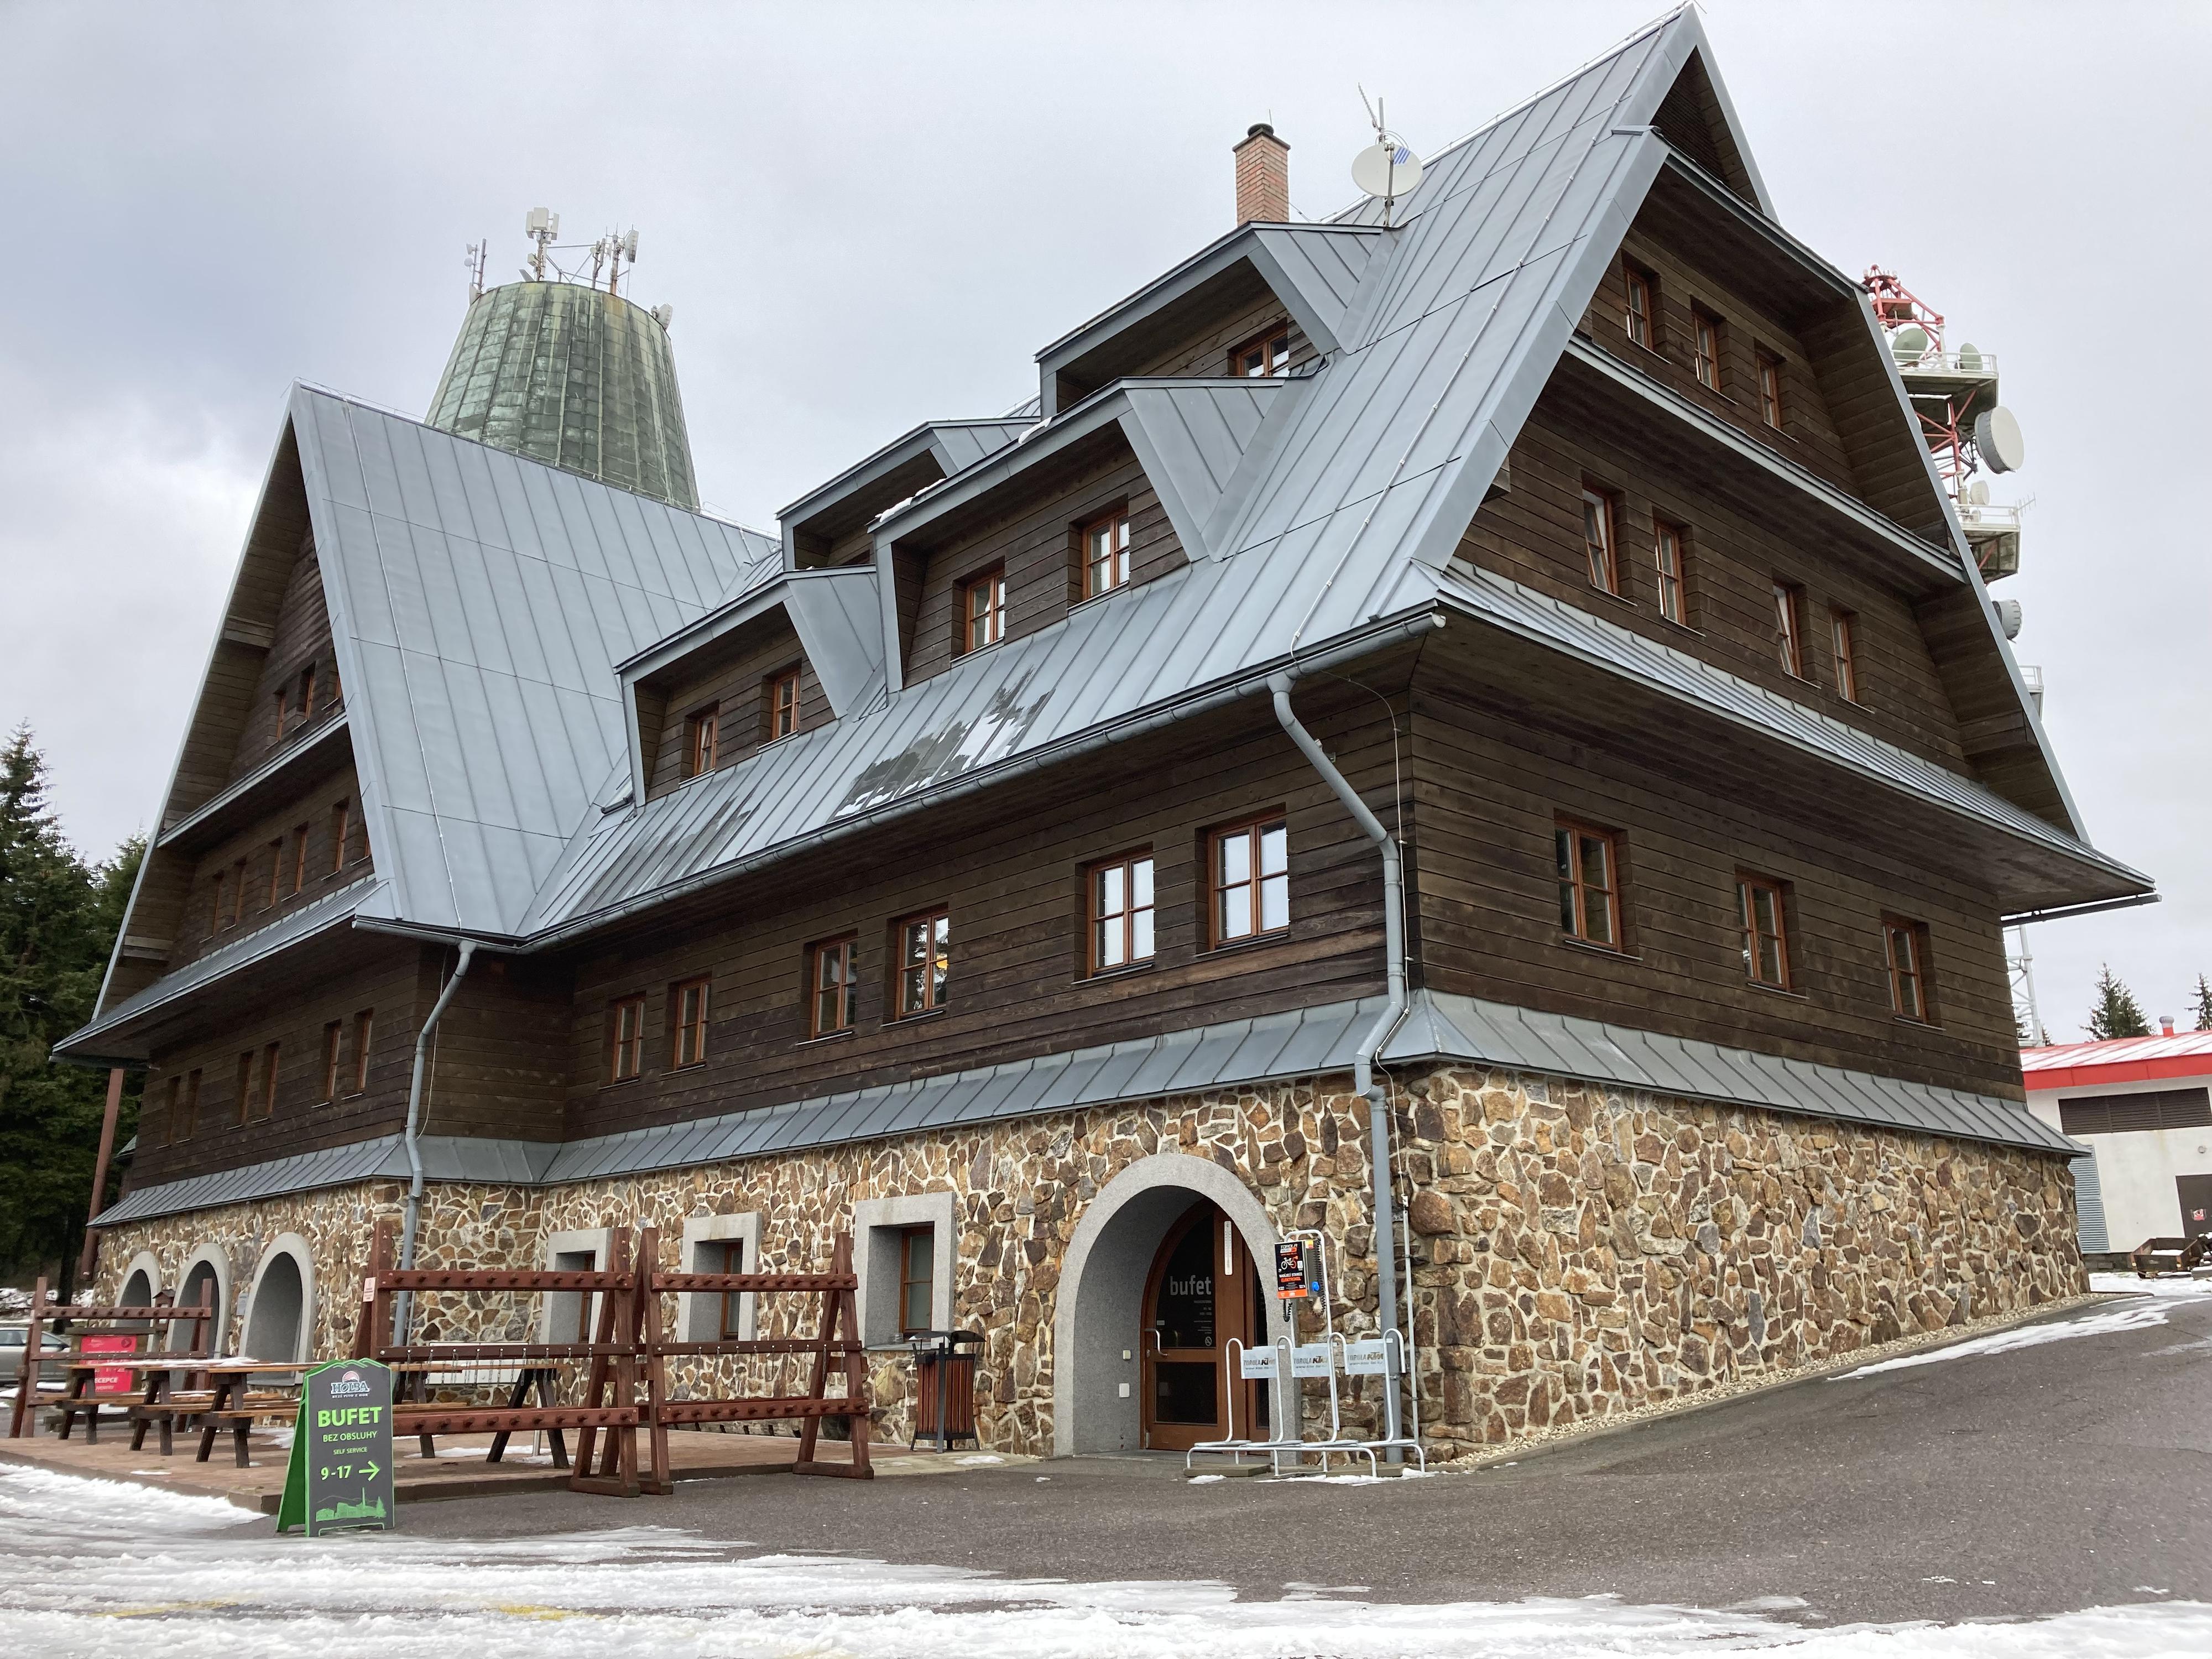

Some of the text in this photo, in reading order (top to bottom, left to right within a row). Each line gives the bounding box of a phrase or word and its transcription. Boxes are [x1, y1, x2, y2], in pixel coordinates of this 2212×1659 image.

[1170, 1275, 1212, 1295] bufet
[331, 1381, 369, 1394] HOLBA
[318, 1406, 382, 1427] BUFET
[322, 1430, 378, 1442] BEZ OBSLUHY
